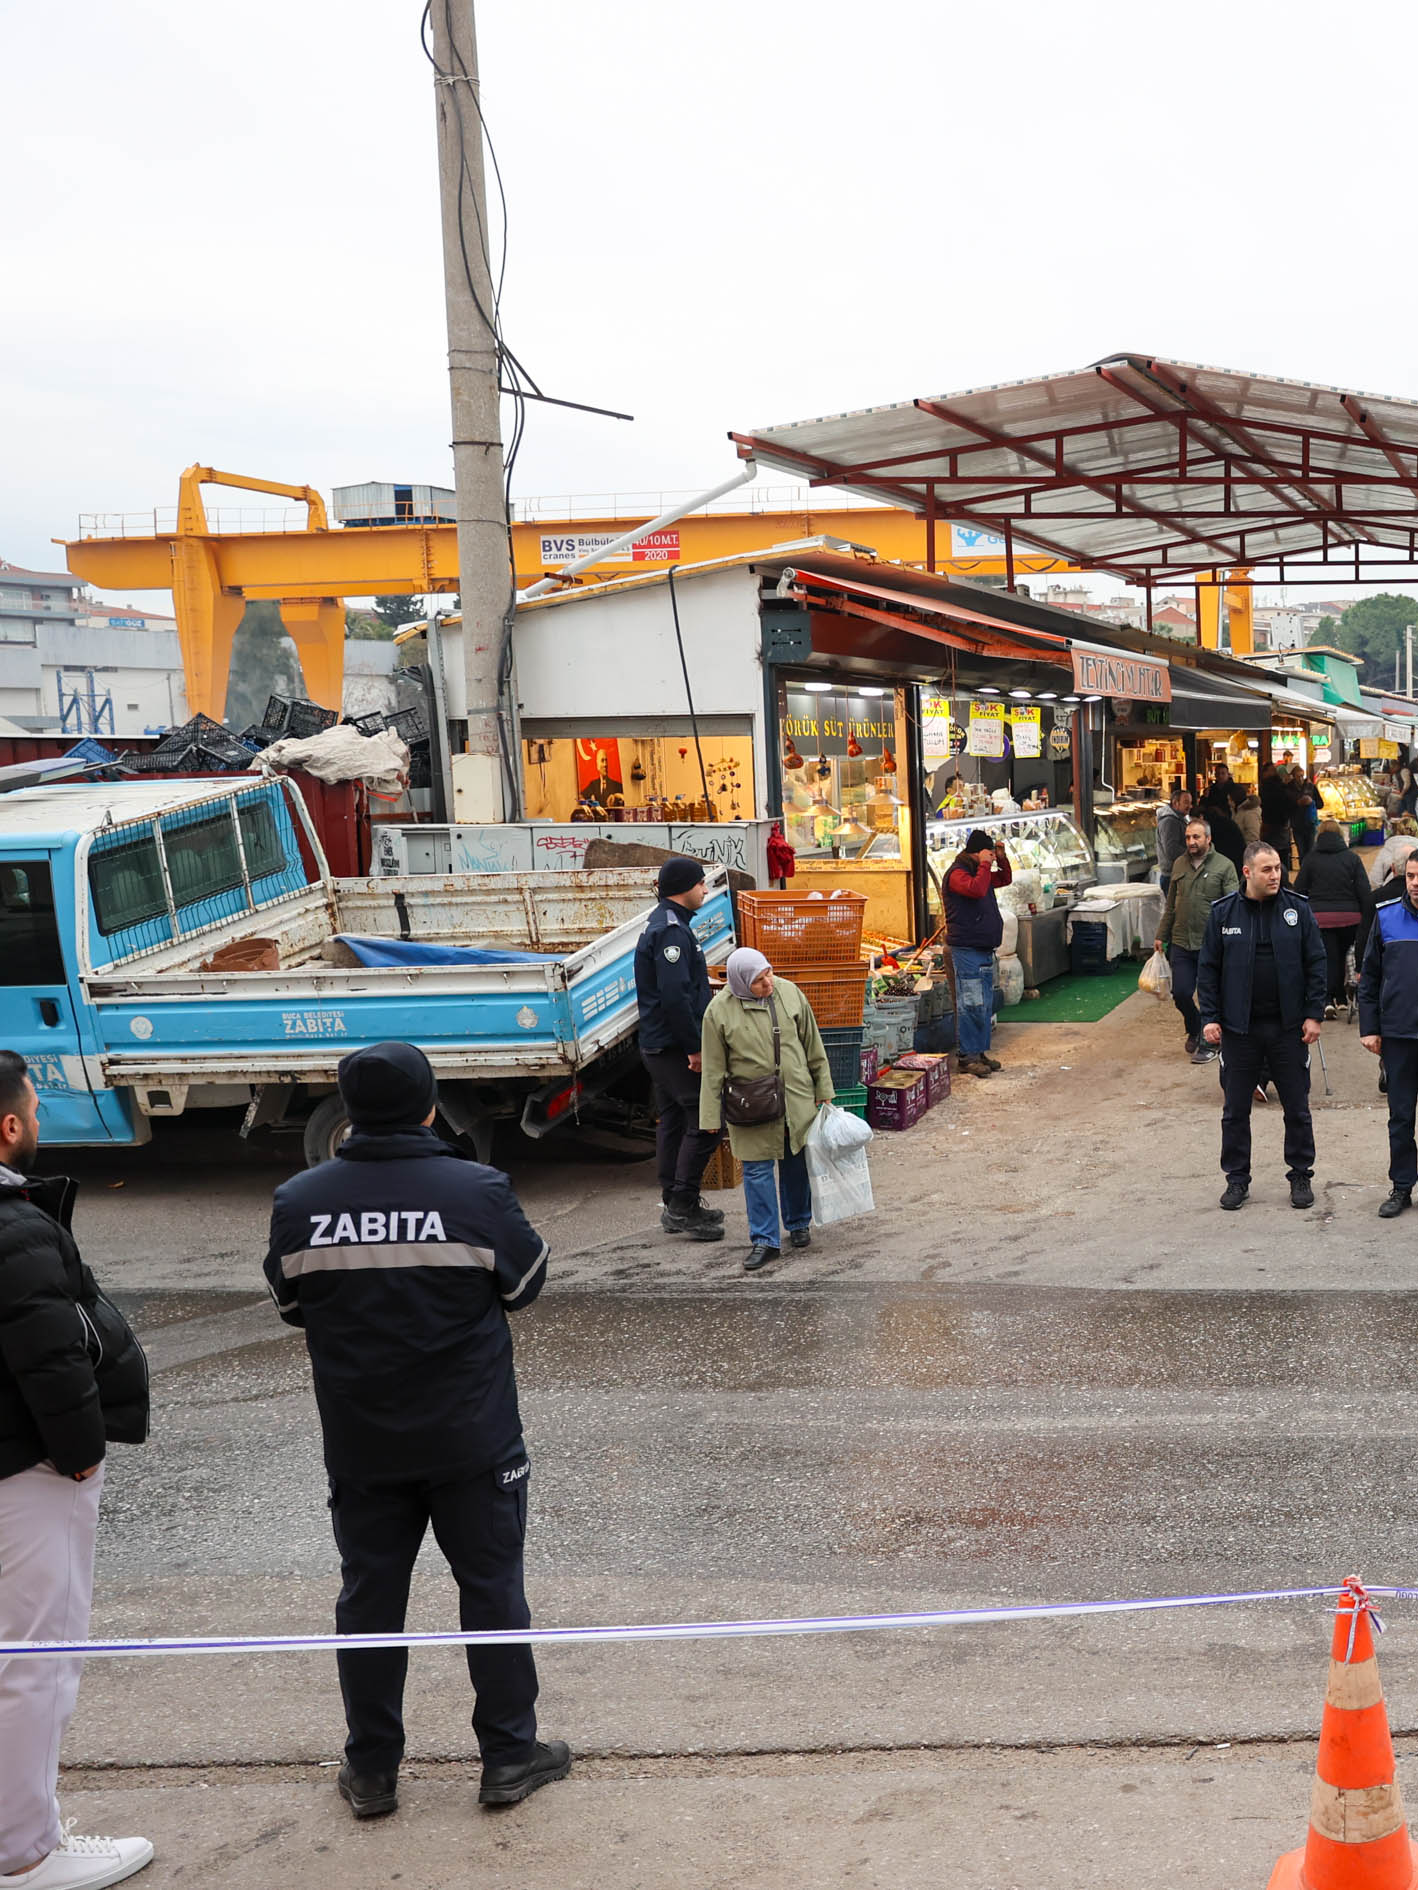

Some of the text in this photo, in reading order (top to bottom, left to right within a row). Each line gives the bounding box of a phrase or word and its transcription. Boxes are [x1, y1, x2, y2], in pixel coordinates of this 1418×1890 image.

[542, 539, 576, 552] BVS
[543, 552, 576, 560] cranes
[644, 550, 669, 561] 2020
[823, 715, 844, 738] SÜT
[283, 1017, 347, 1034] ZABITA
[310, 1211, 447, 1247] ZABITA
